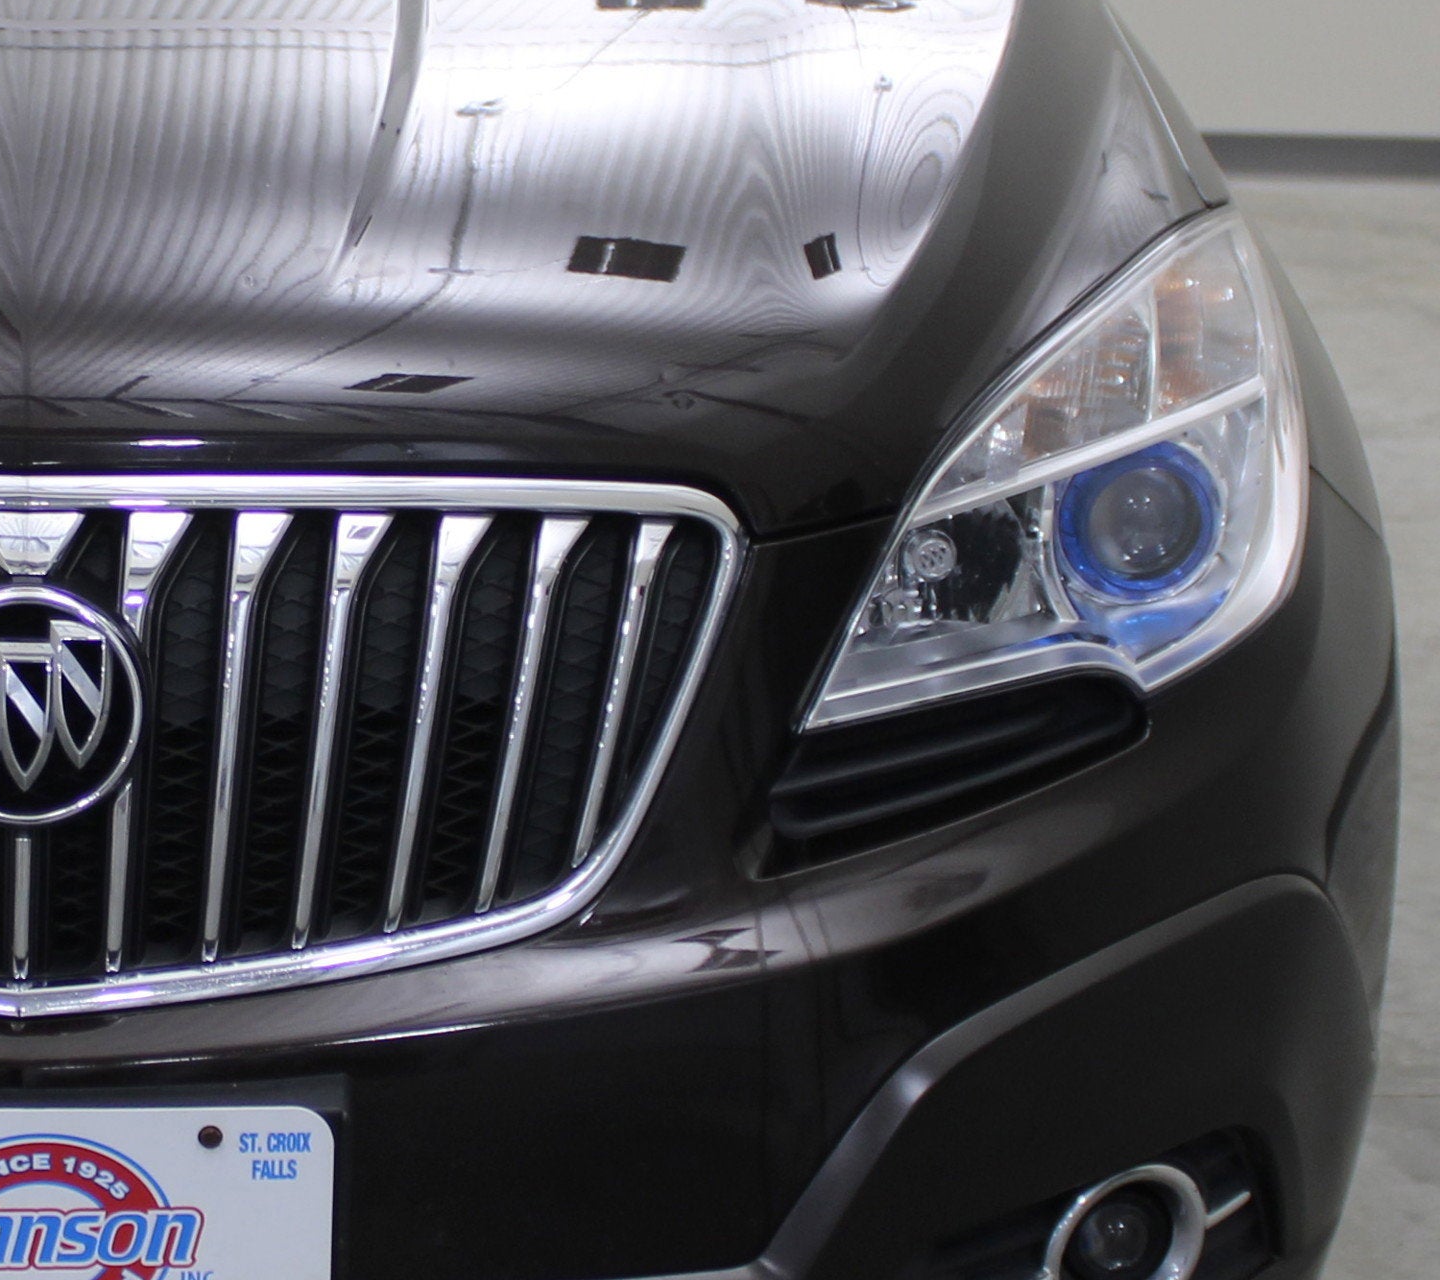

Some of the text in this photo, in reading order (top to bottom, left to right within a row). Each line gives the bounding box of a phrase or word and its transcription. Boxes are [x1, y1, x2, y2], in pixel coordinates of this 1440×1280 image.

[239, 1132, 312, 1153] ST. CROIX
[62, 1156, 131, 1201] 1925
[251, 1160, 297, 1180] FALLS
